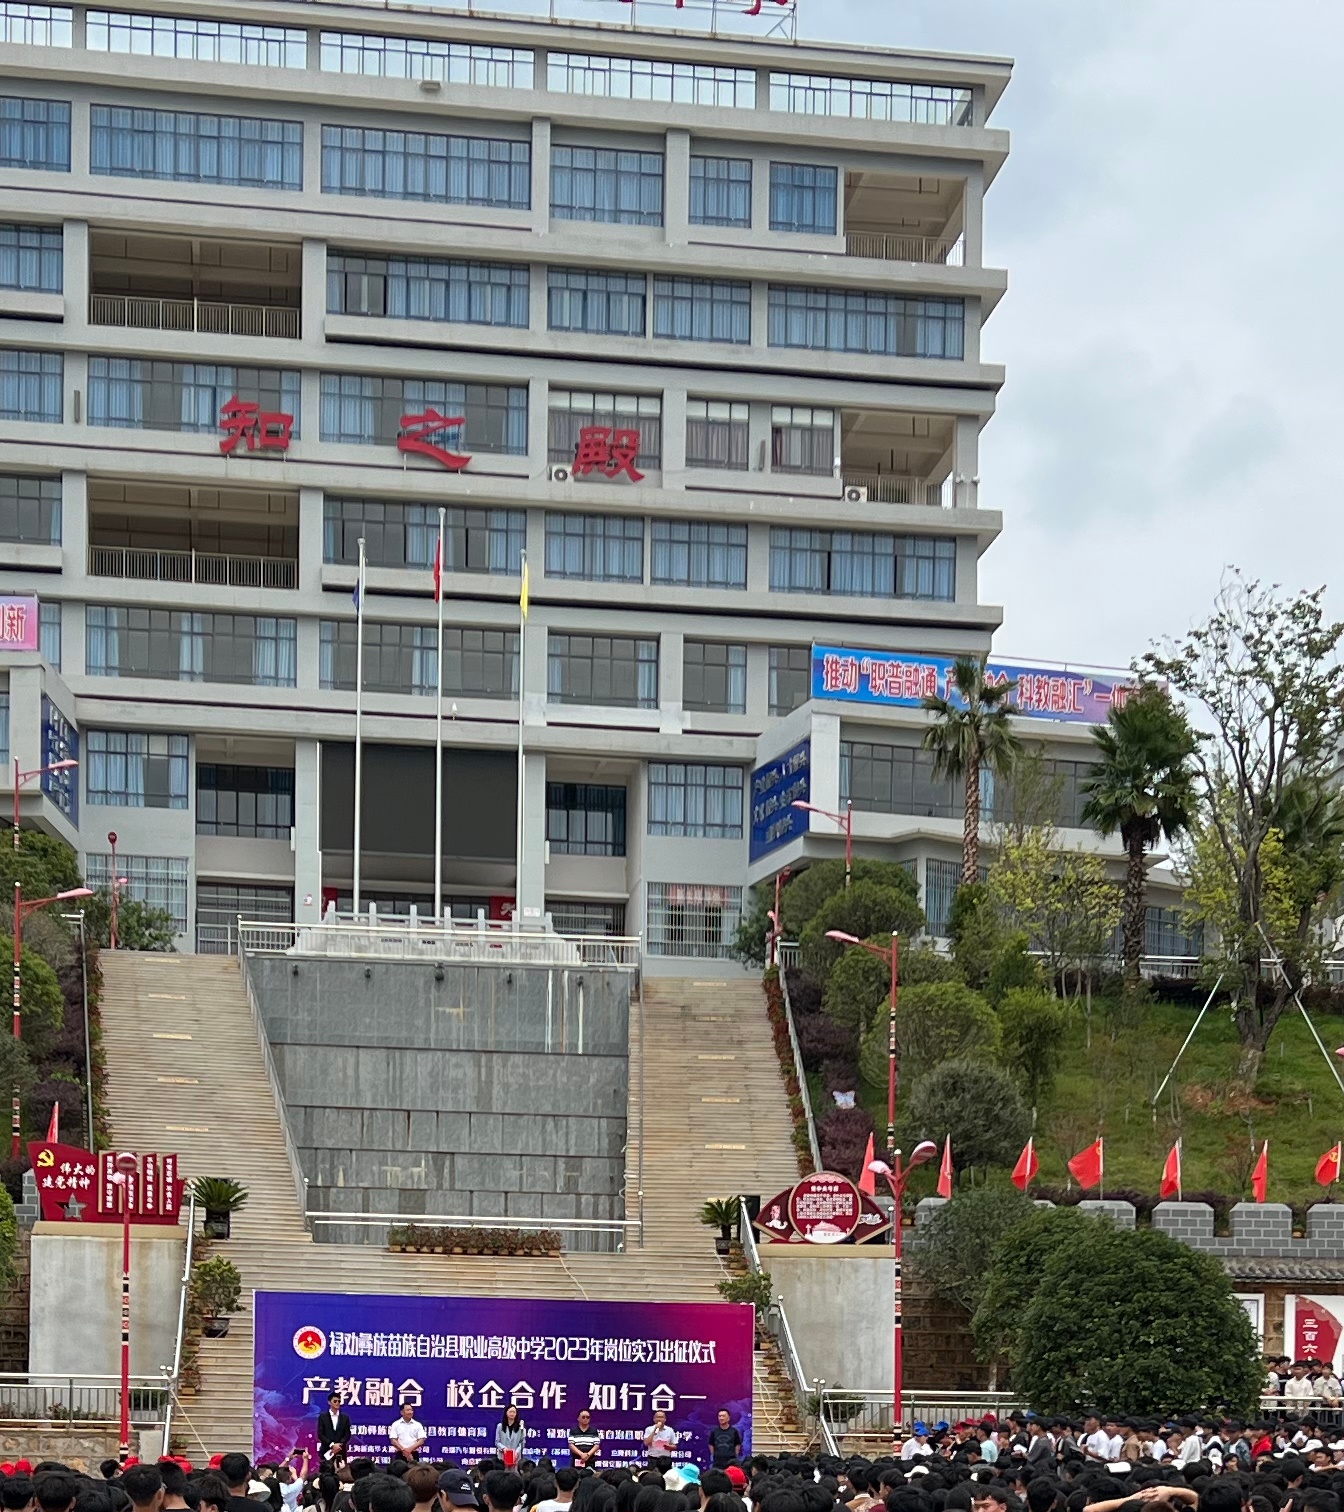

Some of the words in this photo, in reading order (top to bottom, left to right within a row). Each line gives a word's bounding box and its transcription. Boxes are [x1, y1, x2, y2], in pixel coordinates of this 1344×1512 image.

[823, 655, 940, 700] 推动“职普融通
[42, 1174, 91, 1190] 建党精神
[59, 1162, 96, 1176] 伟大的
[329, 1330, 717, 1365] 禄劝彝族苗族自治县职业高级中学2023年岗位实习出征仪式
[302, 1375, 425, 1408] 产教融合
[446, 1379, 568, 1411] 校企合作
[588, 1381, 709, 1413] 知行合一
